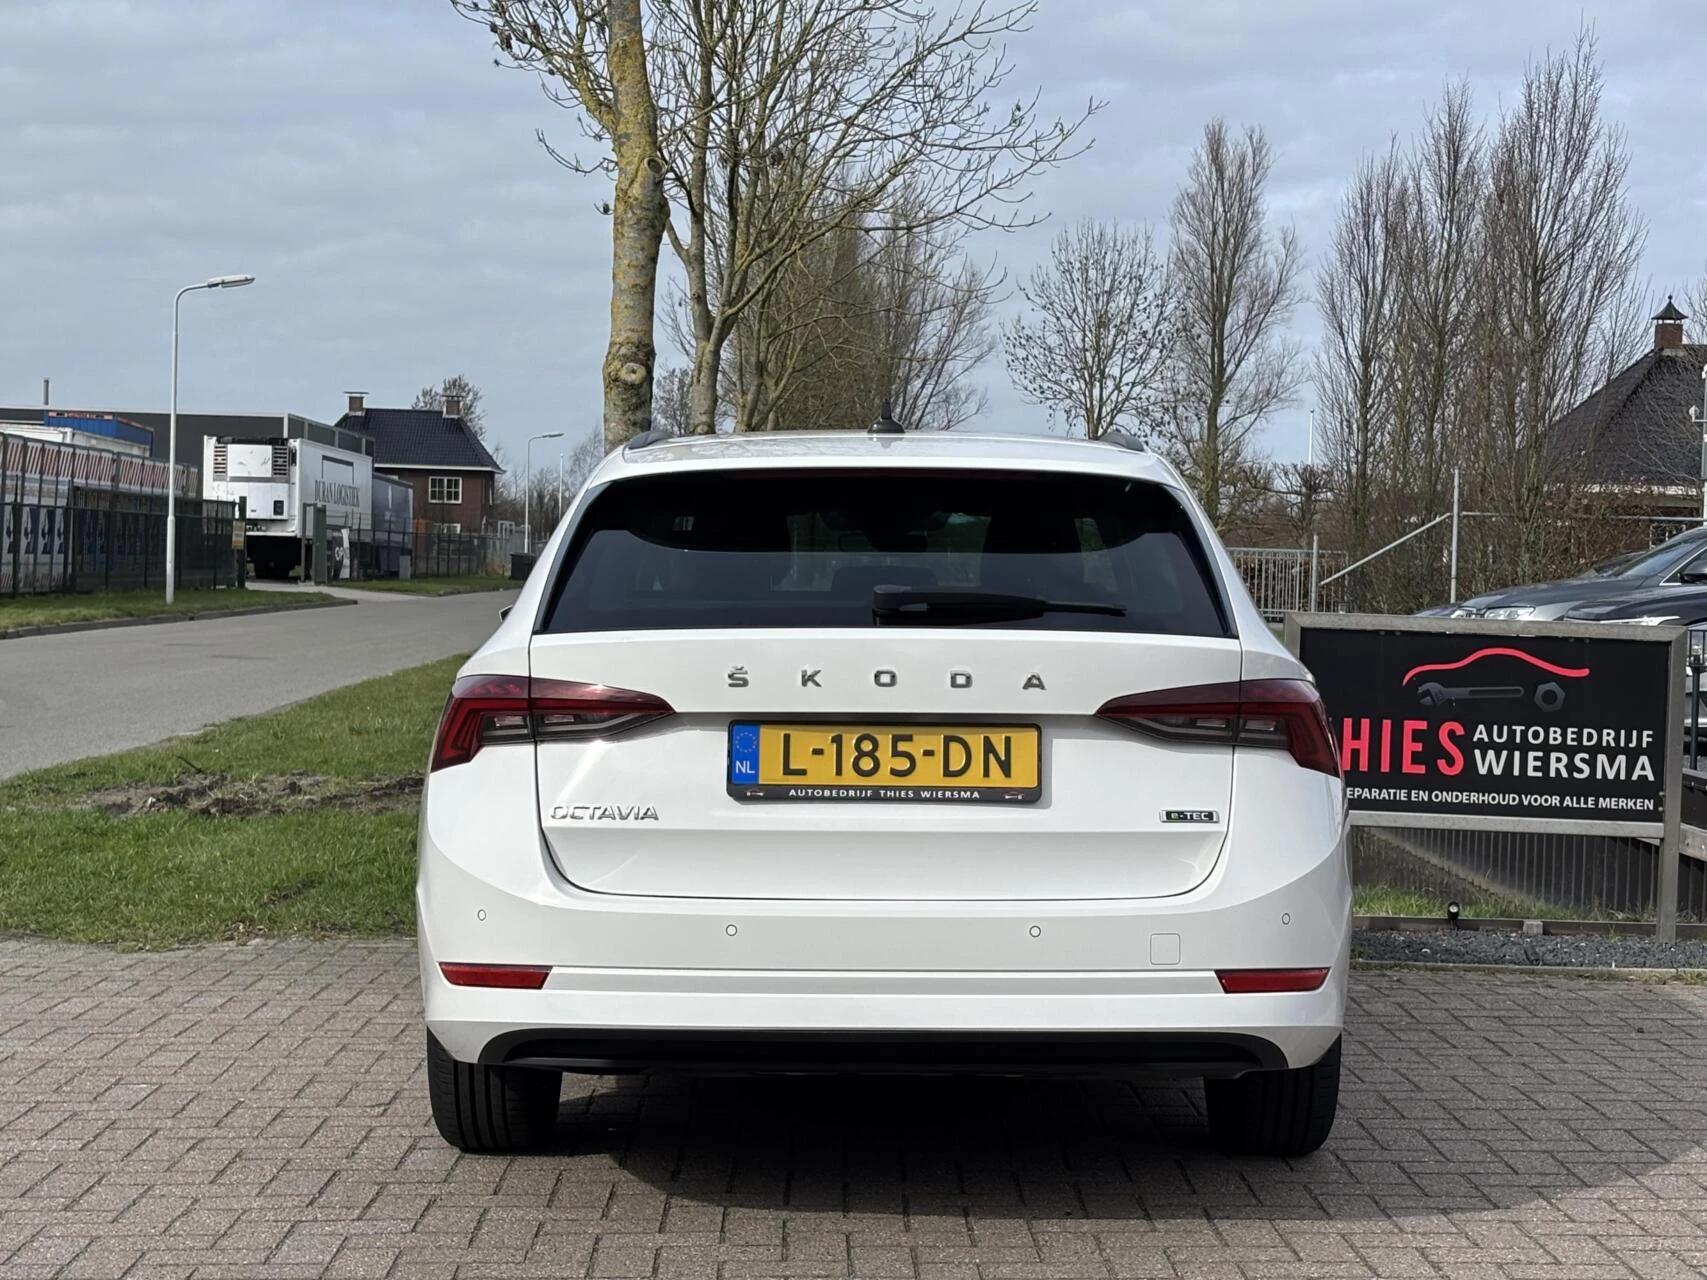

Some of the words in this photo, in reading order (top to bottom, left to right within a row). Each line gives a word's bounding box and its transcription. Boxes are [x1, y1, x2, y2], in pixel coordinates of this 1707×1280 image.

[727, 665, 1047, 690] ŠKODA
[1341, 717, 1465, 776] HIES
[1472, 724, 1654, 748] AUTOBEDRIJF
[735, 760, 755, 774] NL
[782, 733, 1012, 778] L-185-DN
[1473, 749, 1655, 781] WIERSMA
[788, 788, 873, 798] AUTOBEDRIJF
[879, 789, 914, 799] THIES
[920, 789, 980, 799] WIERSMA
[1346, 787, 1408, 801] EPARATIE
[1411, 789, 1429, 802] EN
[1431, 790, 1519, 806] ONDERHOUD
[1521, 794, 1561, 808] VOOR
[1563, 795, 1596, 809] ALLE
[1598, 797, 1655, 811] MERKEN
[550, 805, 659, 821] OCTAVIA
